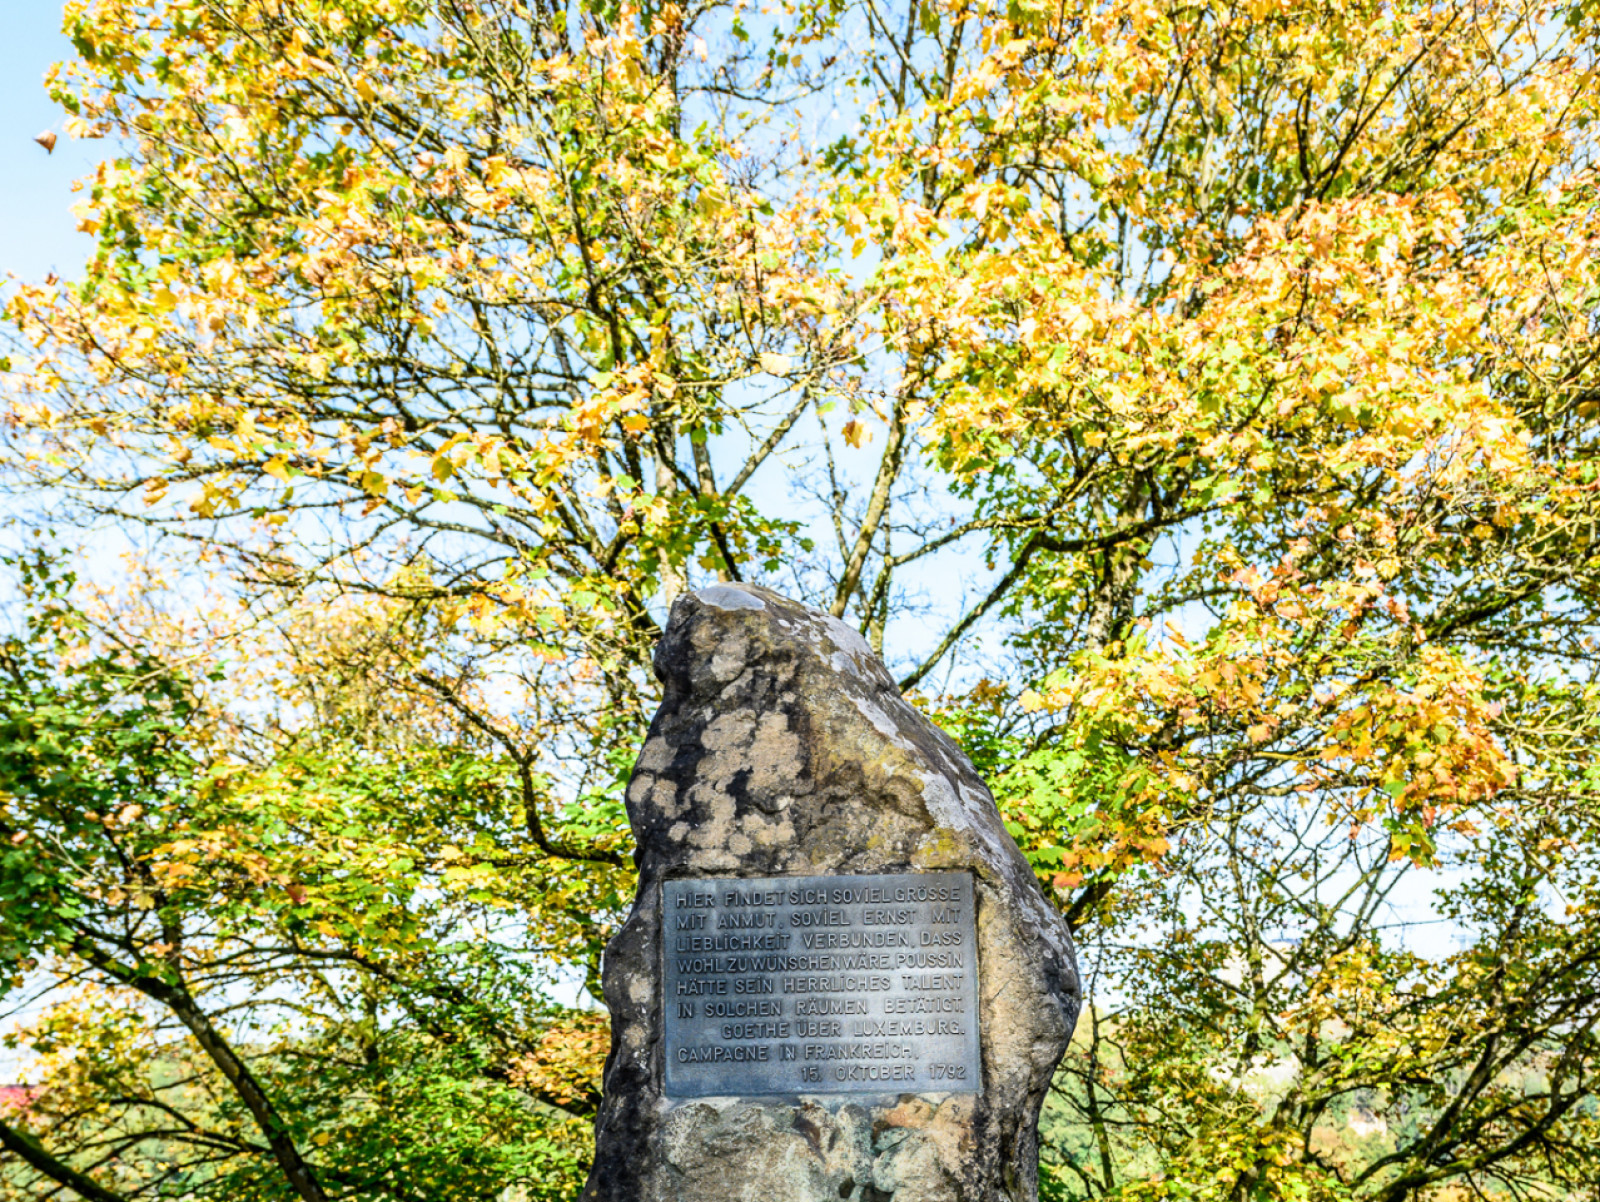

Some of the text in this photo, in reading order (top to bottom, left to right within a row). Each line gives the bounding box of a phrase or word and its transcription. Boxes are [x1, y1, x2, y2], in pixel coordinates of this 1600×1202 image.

[676, 885, 960, 908] HIER FINDET SICH SOVIEL GRÖSSE
[676, 914, 706, 930] MIT
[791, 909, 851, 927] SOVIEL
[863, 909, 916, 925] ERNST
[932, 908, 961, 924] MIT
[676, 934, 790, 952] LIEBLICHKEIT
[920, 931, 962, 946] DASS
[678, 958, 725, 973] WOHL
[727, 957, 748, 972] ZU
[750, 954, 841, 973] WÜNSCHEN
[896, 952, 963, 968] POUSSIN
[677, 976, 963, 995] HÄTTE SEIN HERRLICHES TALENT
[678, 1002, 694, 1018] IN
[705, 1001, 781, 1017] SOLCHEN
[796, 998, 867, 1015] RÄUMEN
[721, 1023, 790, 1039] GOETHE
[678, 1046, 769, 1063] CAMPAGNE
[780, 1044, 796, 1060] IN
[835, 1065, 915, 1081] OKTOBER
[929, 1063, 967, 1080] 1792
